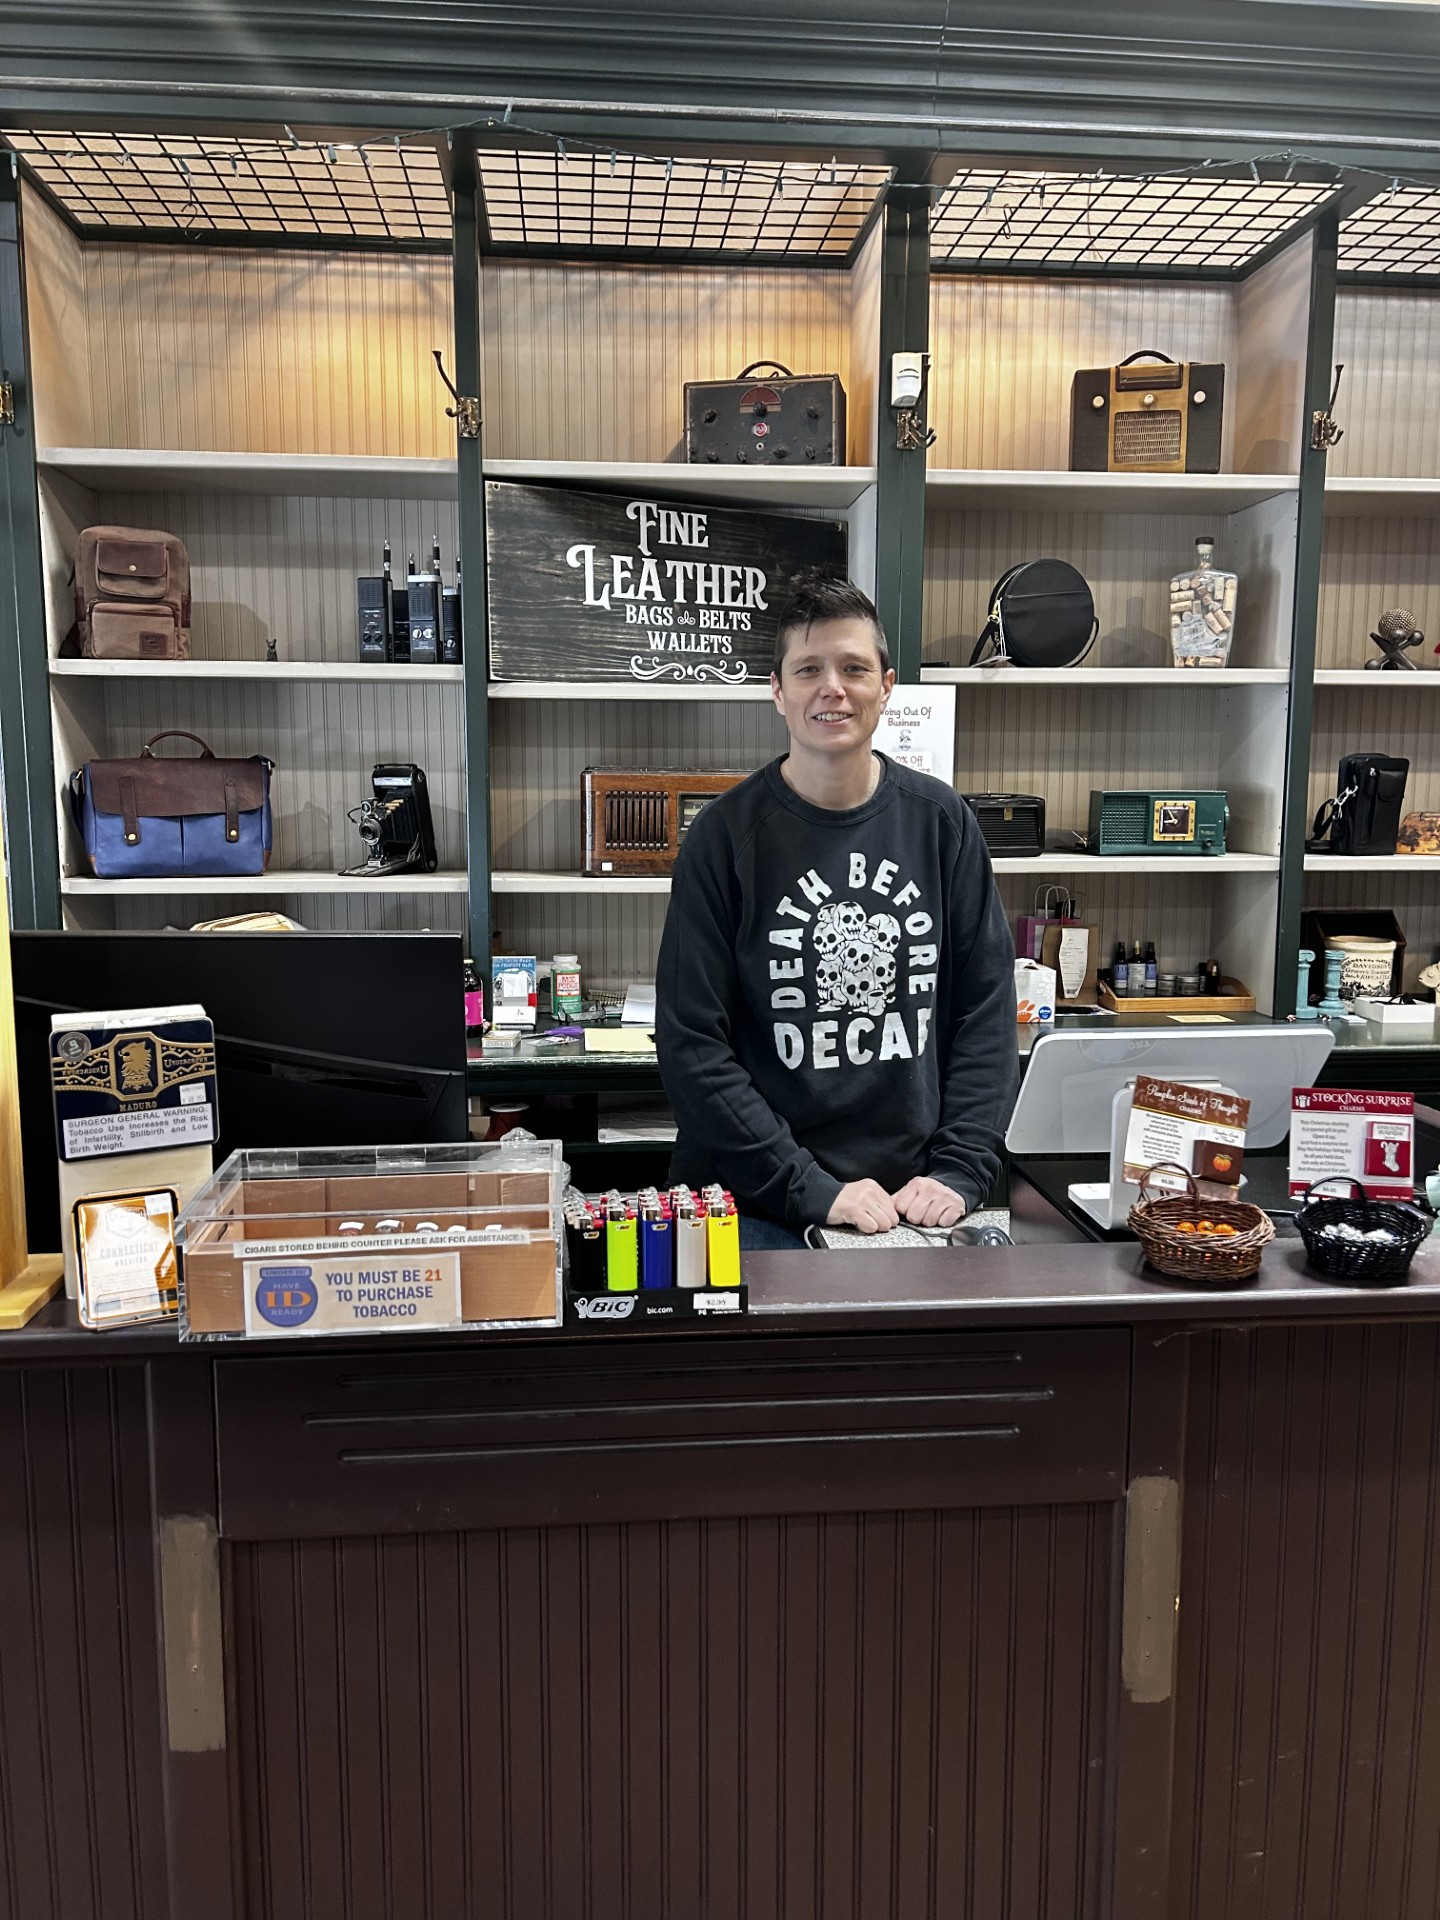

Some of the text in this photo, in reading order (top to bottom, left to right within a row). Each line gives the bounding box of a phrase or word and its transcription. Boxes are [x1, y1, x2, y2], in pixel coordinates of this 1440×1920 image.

[626, 501, 709, 556] FINE
[566, 544, 768, 610] LEATHER
[624, 604, 752, 631] BAGS BELTS
[646, 631, 732, 654] WALLETS
[884, 706, 932, 719] oing Out Of
[888, 718, 920, 726] Business
[848, 852, 938, 995] BEFORE
[769, 868, 833, 1009] DEATH
[1146, 1084, 1176, 1102] Pumpkin
[1312, 1092, 1412, 1107] STOCKING SURPRISE
[119, 1101, 158, 1112] MADURO
[68, 1106, 208, 1129] SURGEON GENERAL WARNING:
[69, 1127, 104, 1137] Tobacco
[108, 1124, 124, 1132] Use
[129, 1120, 169, 1130] Increases
[190, 1115, 208, 1123] Risk
[84, 1134, 124, 1144] Infertility,
[130, 1129, 164, 1139] Stillbirth
[192, 1122, 208, 1131] Low
[70, 1142, 125, 1154] Birth Weight.
[245, 1246, 277, 1254] CIGARS
[279, 1244, 314, 1252] STORED
[316, 1242, 349, 1250] BEHIND
[350, 1239, 393, 1248] COUNTER
[394, 1236, 428, 1245] PLEASE
[326, 1269, 442, 1286] YOU MUST BE 21
[264, 1290, 312, 1308] ID
[336, 1286, 433, 1302] TO PURCHASE
[353, 1303, 417, 1318] TOBACCO
